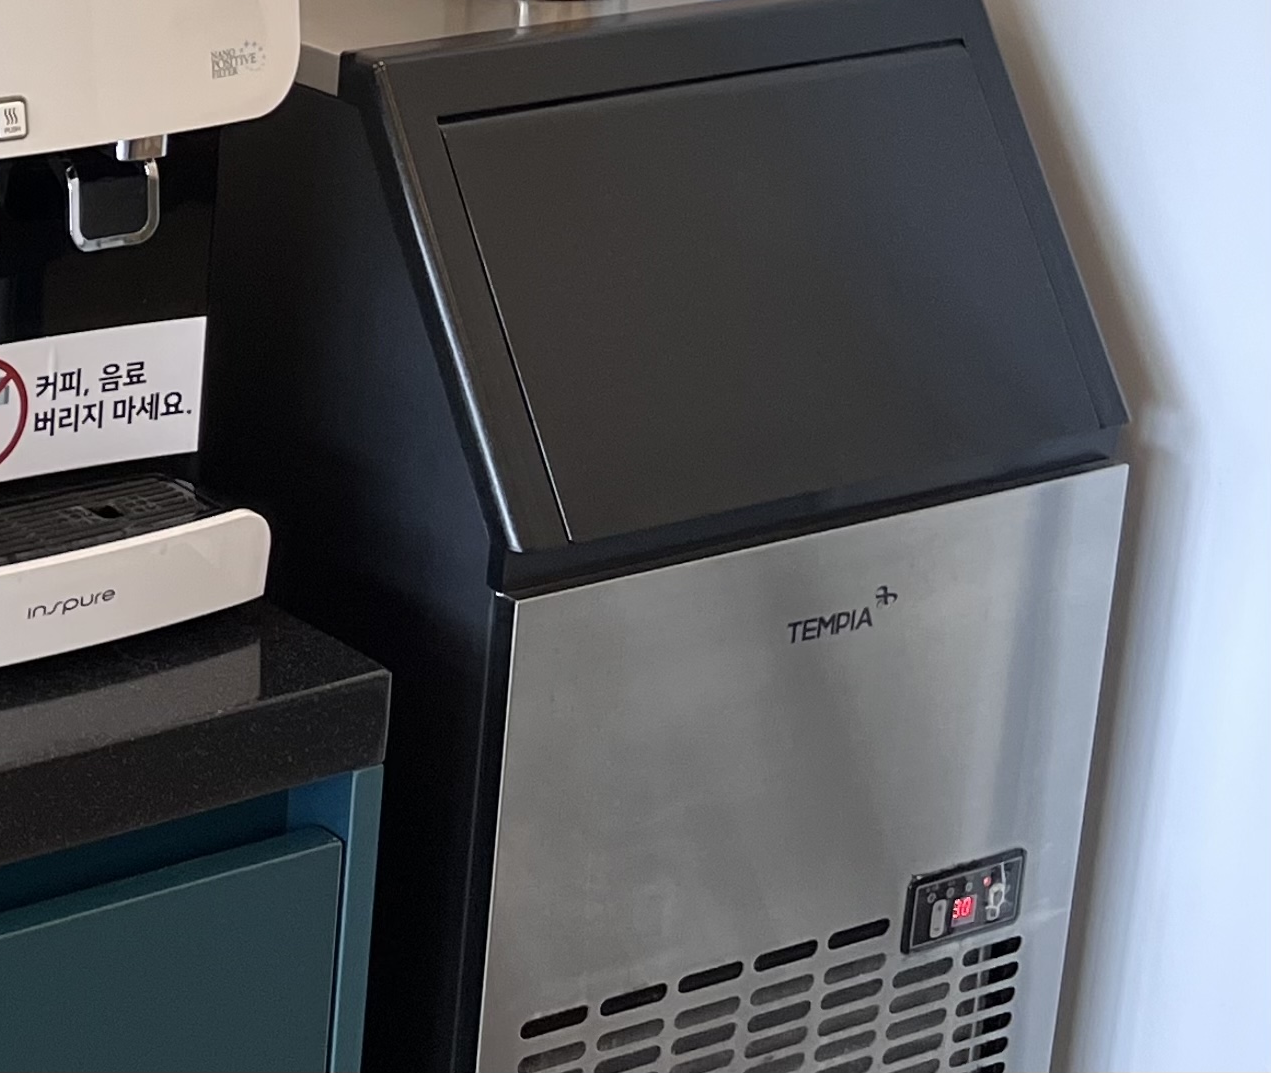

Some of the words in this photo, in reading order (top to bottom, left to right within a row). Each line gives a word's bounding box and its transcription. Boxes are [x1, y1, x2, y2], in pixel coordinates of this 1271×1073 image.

[35, 368, 89, 399] 커피,
[99, 361, 146, 392] 음료
[35, 401, 103, 436] 버리지
[112, 391, 192, 423] 마세요.
[27, 588, 116, 620] inspure
[788, 607, 873, 643] TEMPIA
[953, 896, 973, 919] 30
